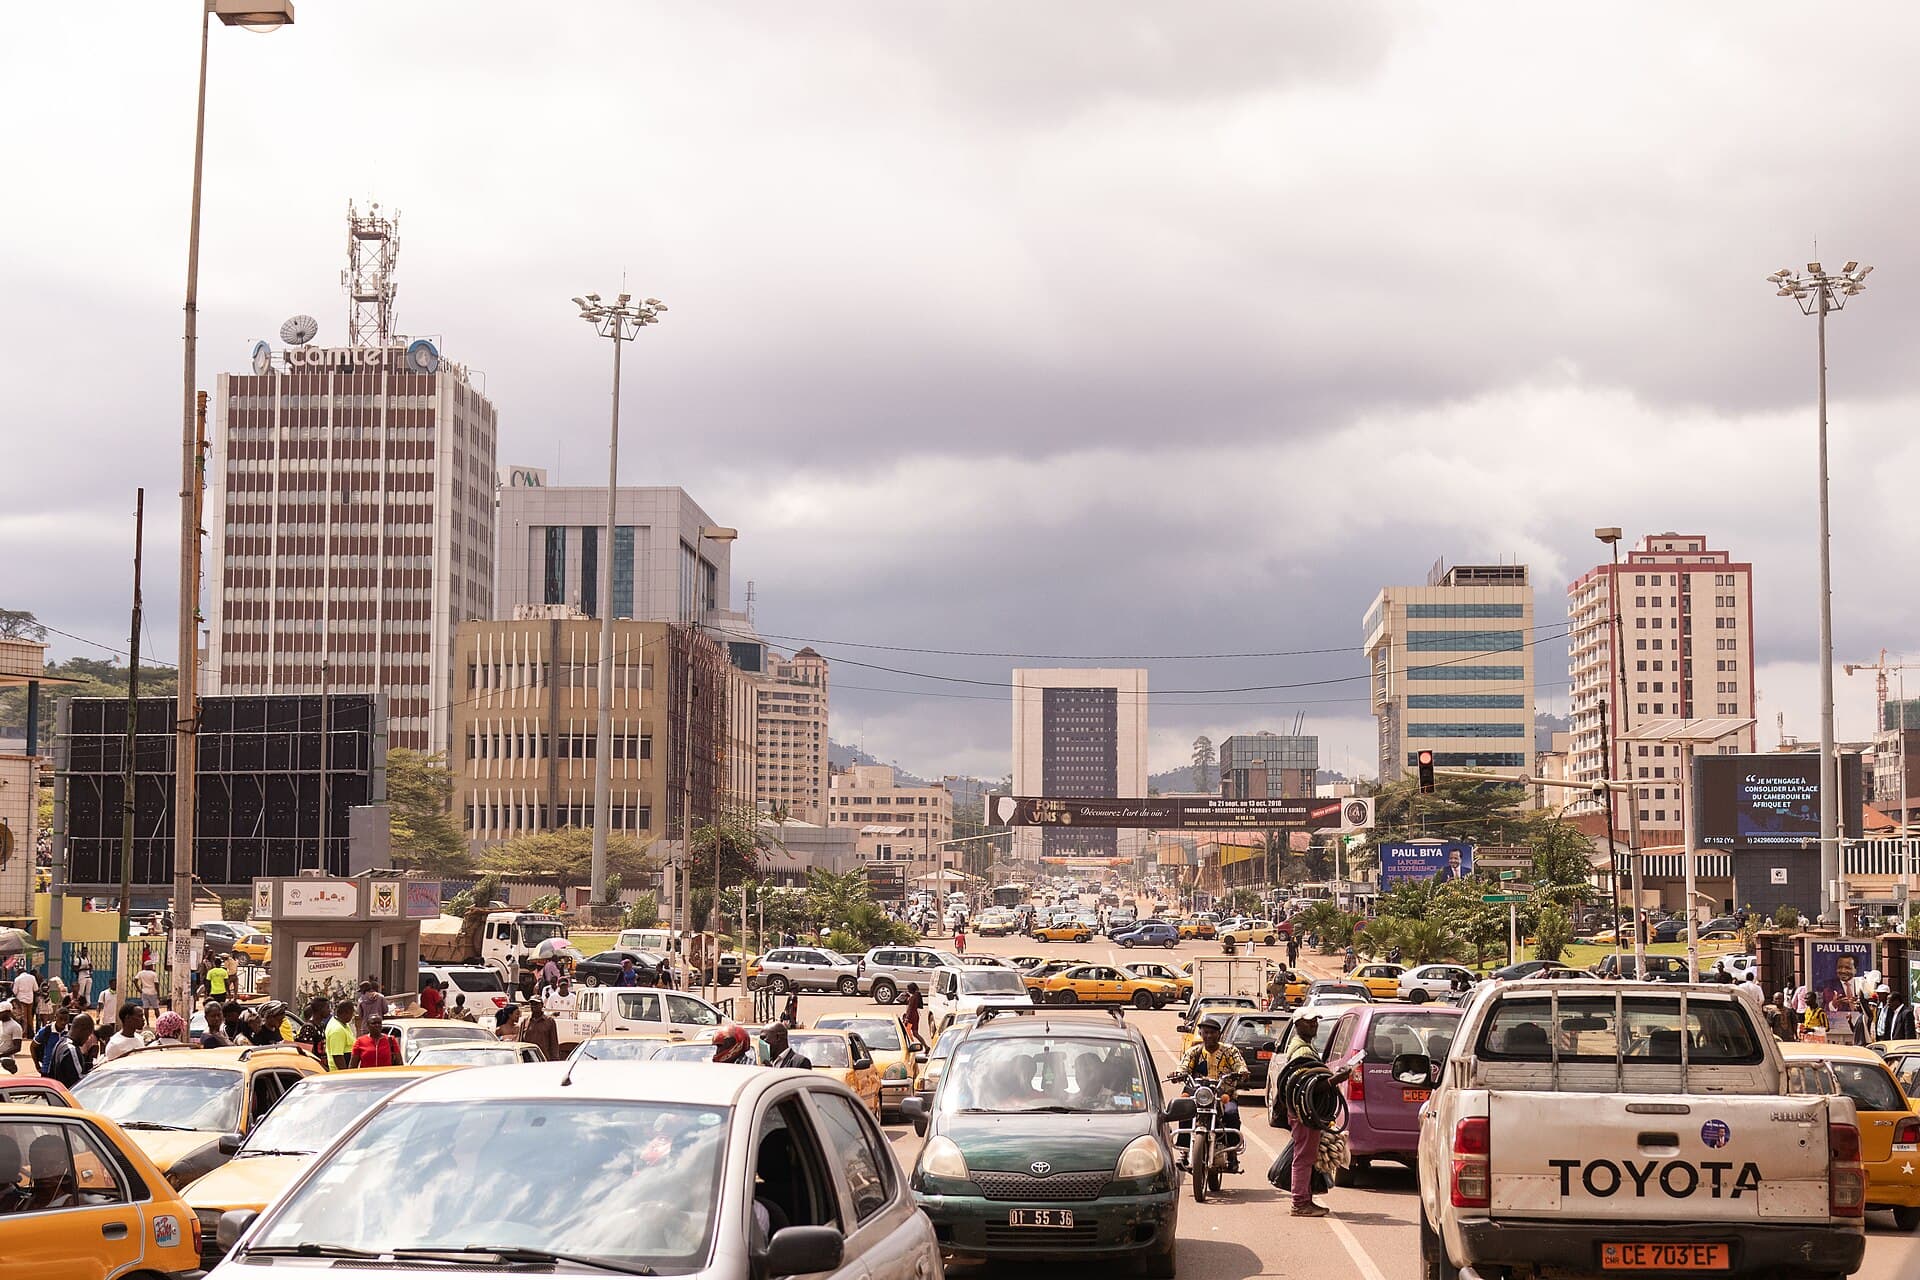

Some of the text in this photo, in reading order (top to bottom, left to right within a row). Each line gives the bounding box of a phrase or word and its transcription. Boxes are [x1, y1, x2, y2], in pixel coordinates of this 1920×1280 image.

[289, 345, 389, 366] camtel
[1035, 800, 1066, 811] FOIRE
[1752, 801, 1782, 809] AFRIQUE
[1032, 811, 1057, 823] VINS
[1139, 807, 1149, 817] du
[1150, 809, 1163, 817] vin
[1391, 848, 1443, 857] PAUL BIYA
[1816, 944, 1867, 953] PAUL BIYA
[1411, 1090, 1424, 1101] CE
[1548, 1158, 1763, 1199] TOYOTA
[1011, 1210, 1072, 1226] 01 55 36
[1622, 1245, 1719, 1265] CE 703 EF
